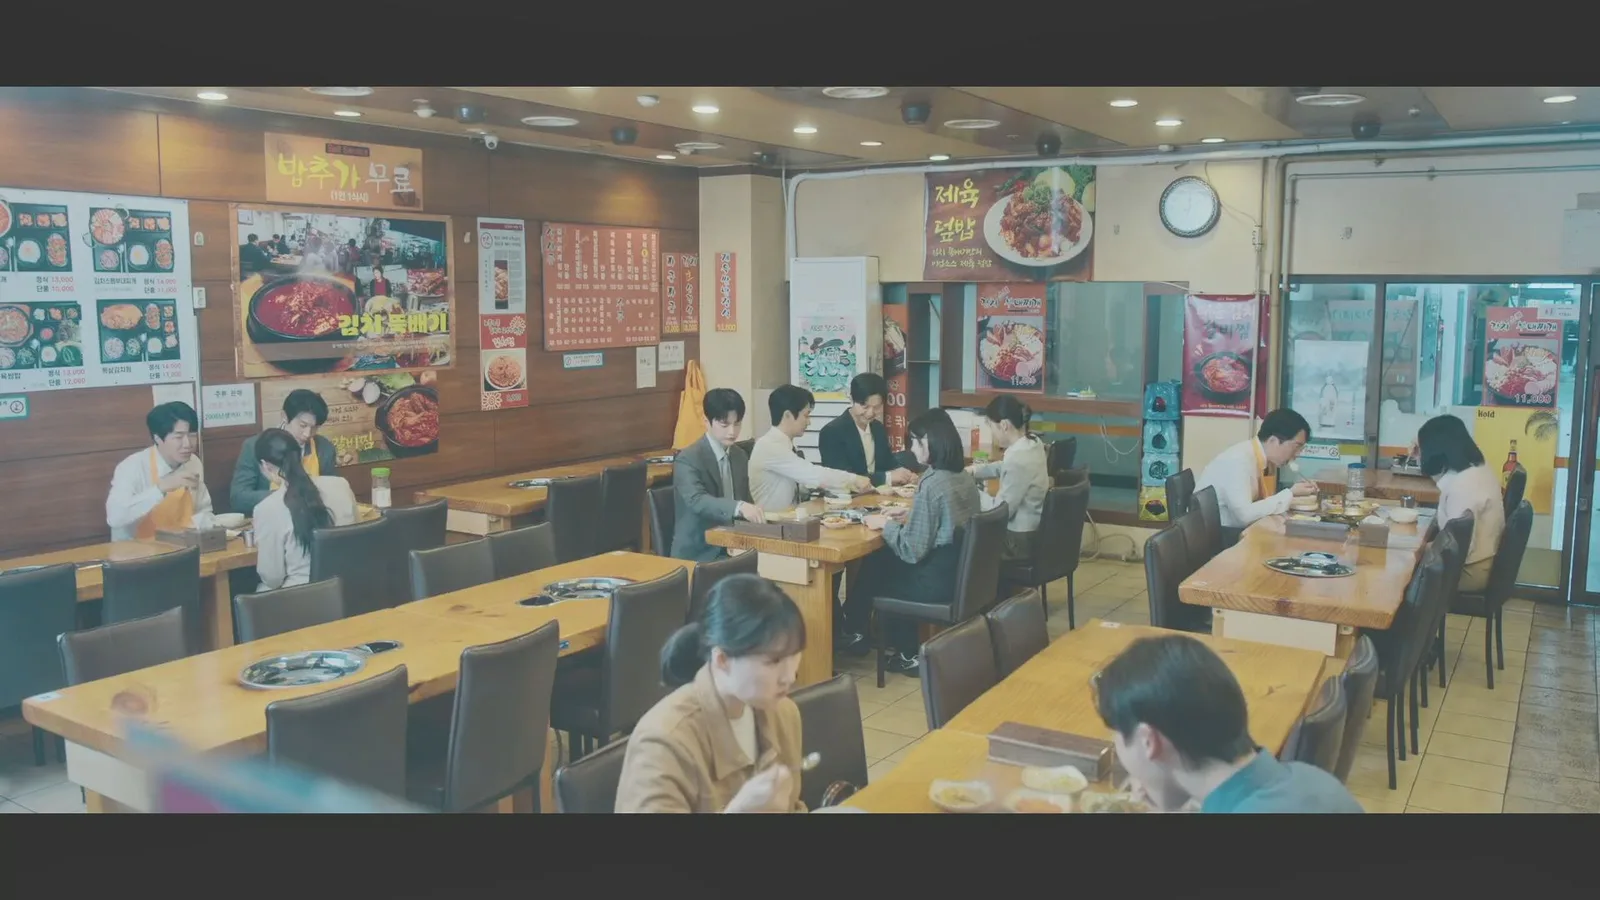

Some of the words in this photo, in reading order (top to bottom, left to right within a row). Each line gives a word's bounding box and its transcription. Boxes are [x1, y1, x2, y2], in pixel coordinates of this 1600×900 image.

[277, 152, 361, 190] 밥추가
[365, 161, 415, 194] 무료
[935, 177, 980, 208] 제육
[934, 215, 977, 243] 덮밥
[36, 276, 49, 284] 정식
[36, 285, 49, 293] 단품
[338, 312, 383, 336] 김치
[389, 312, 447, 335] 뚝배기
[1489, 320, 1510, 332] 김치
[1516, 320, 1558, 332] 부대찌개
[1514, 393, 1551, 404] 11,000
